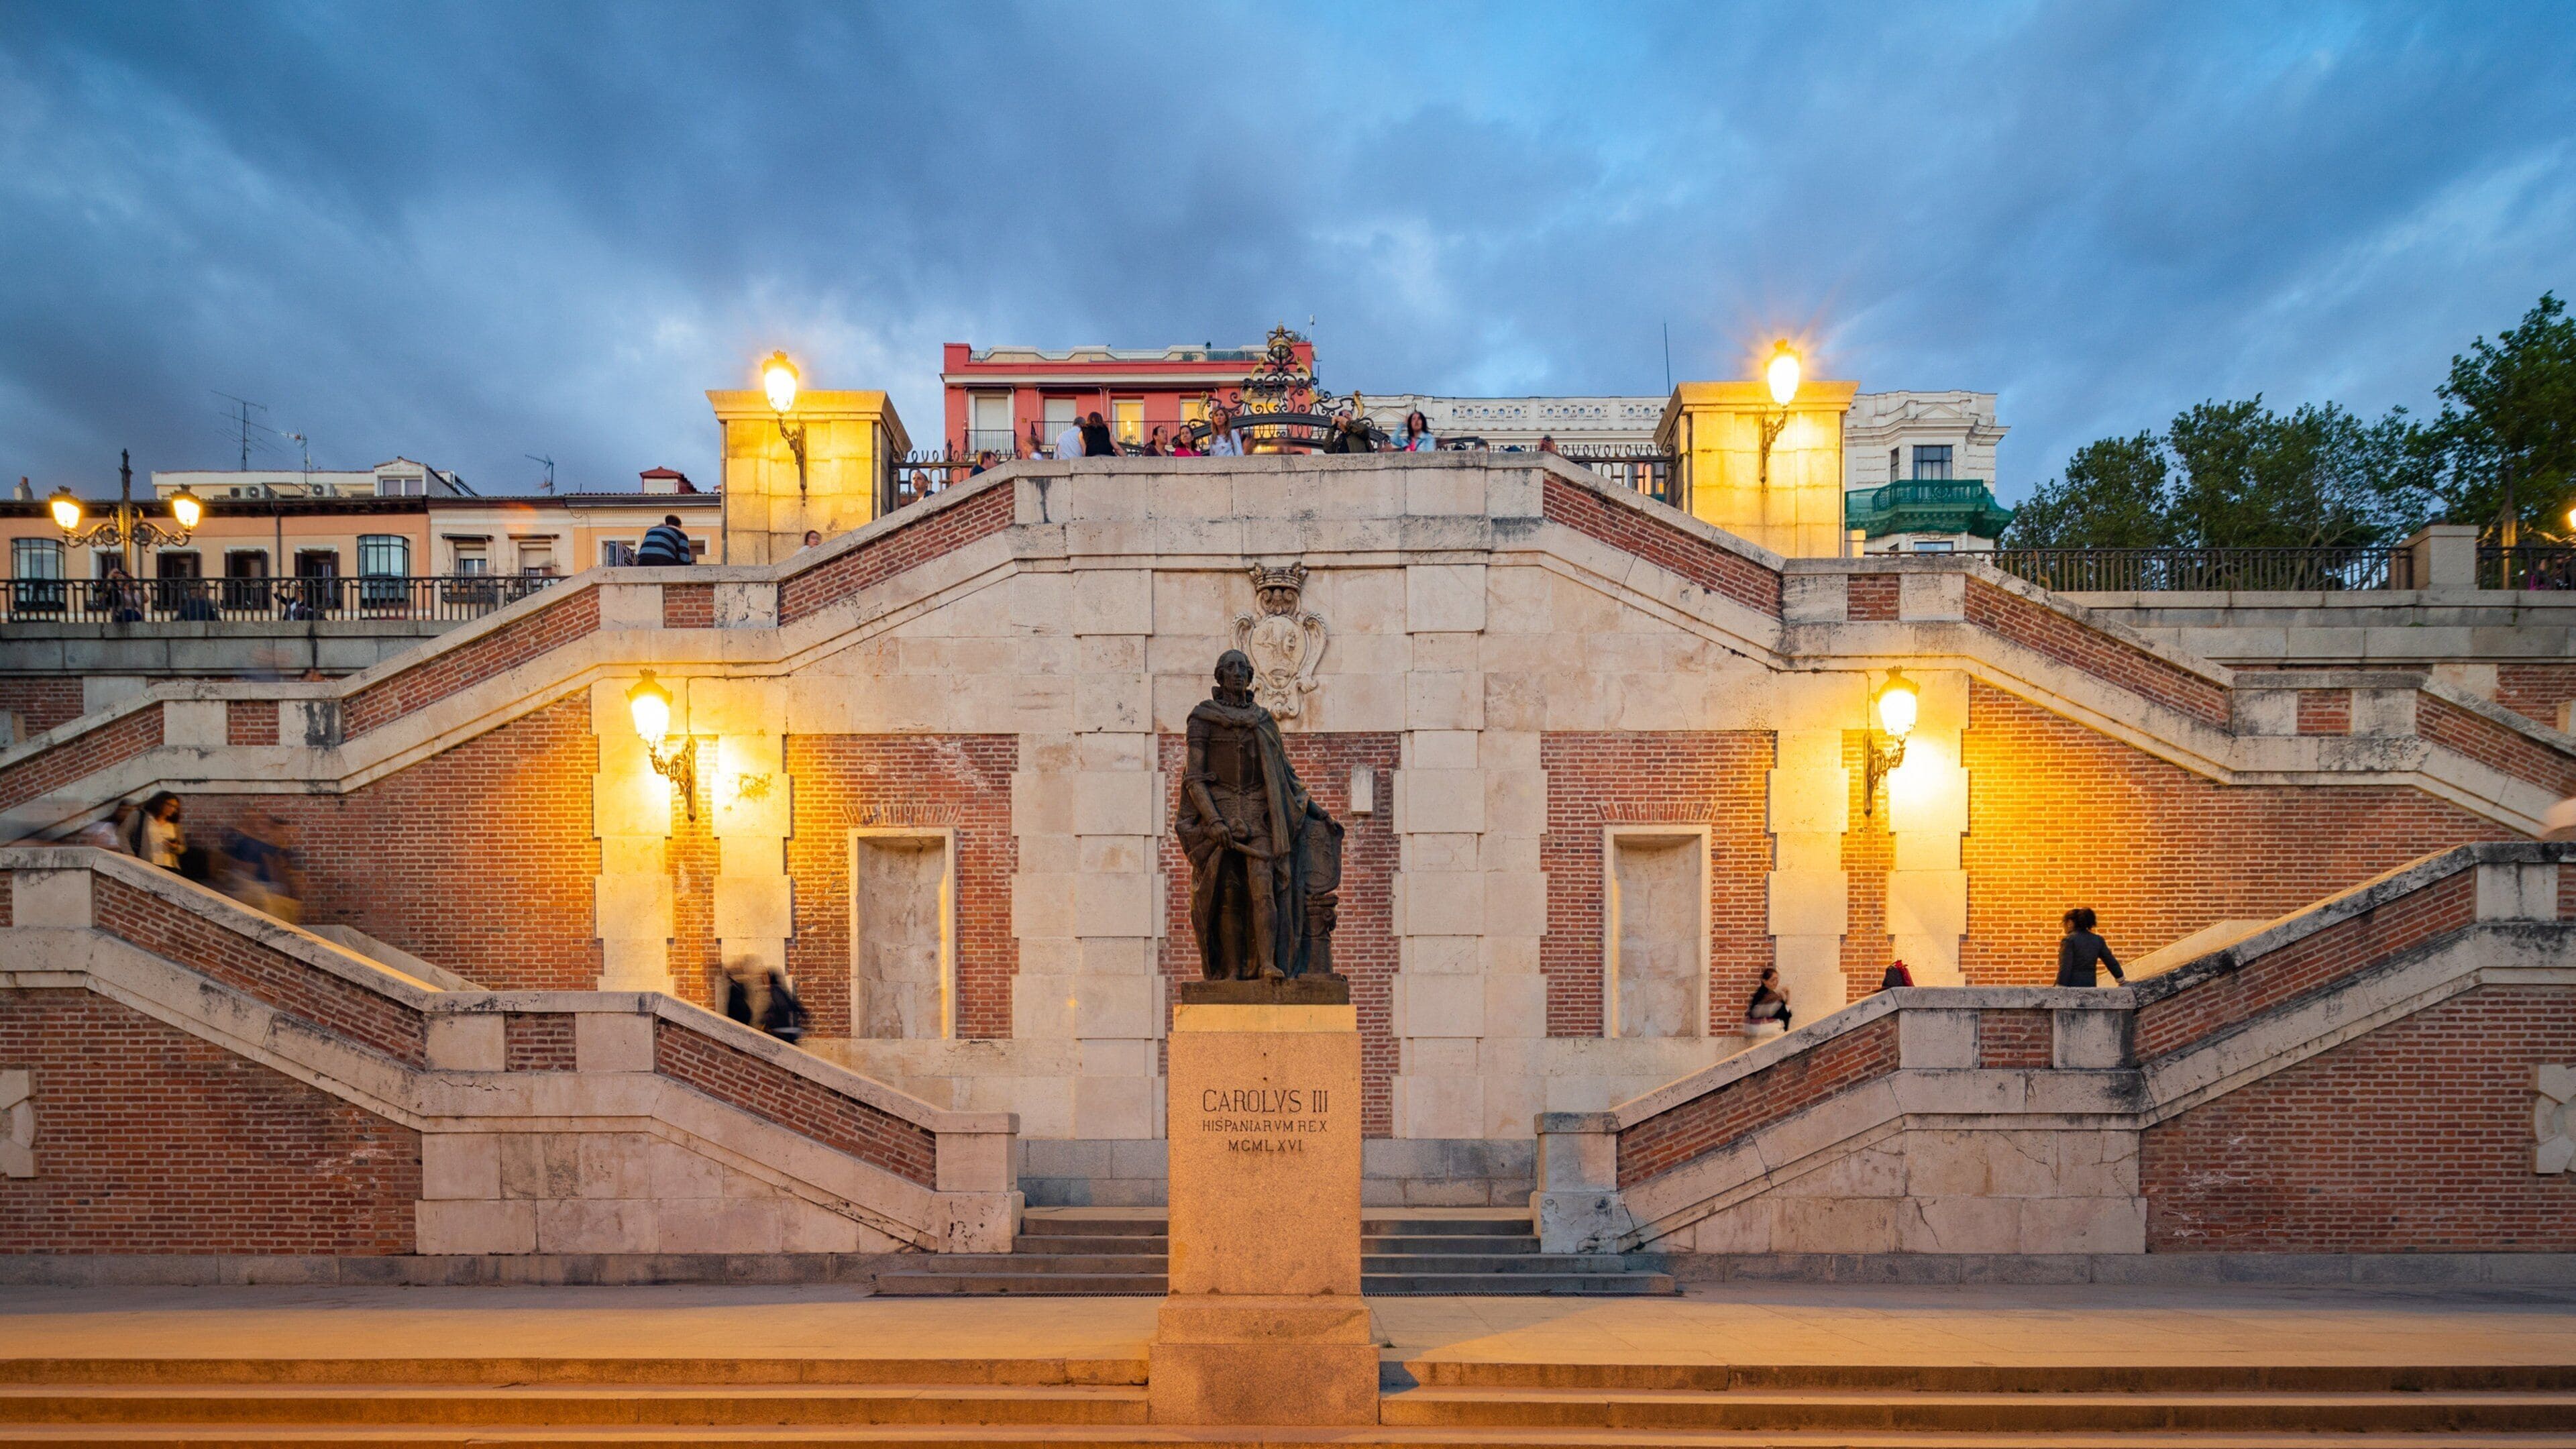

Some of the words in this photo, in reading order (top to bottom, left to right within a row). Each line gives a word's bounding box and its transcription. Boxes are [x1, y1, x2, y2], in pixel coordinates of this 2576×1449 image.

[1203, 1089, 1301, 1113] CAROLVS
[1313, 1090, 1328, 1112] III
[1202, 1120, 1293, 1132] HISPANIARVM
[1298, 1120, 1328, 1132] REX
[1228, 1140, 1302, 1152] MCMLXVI
